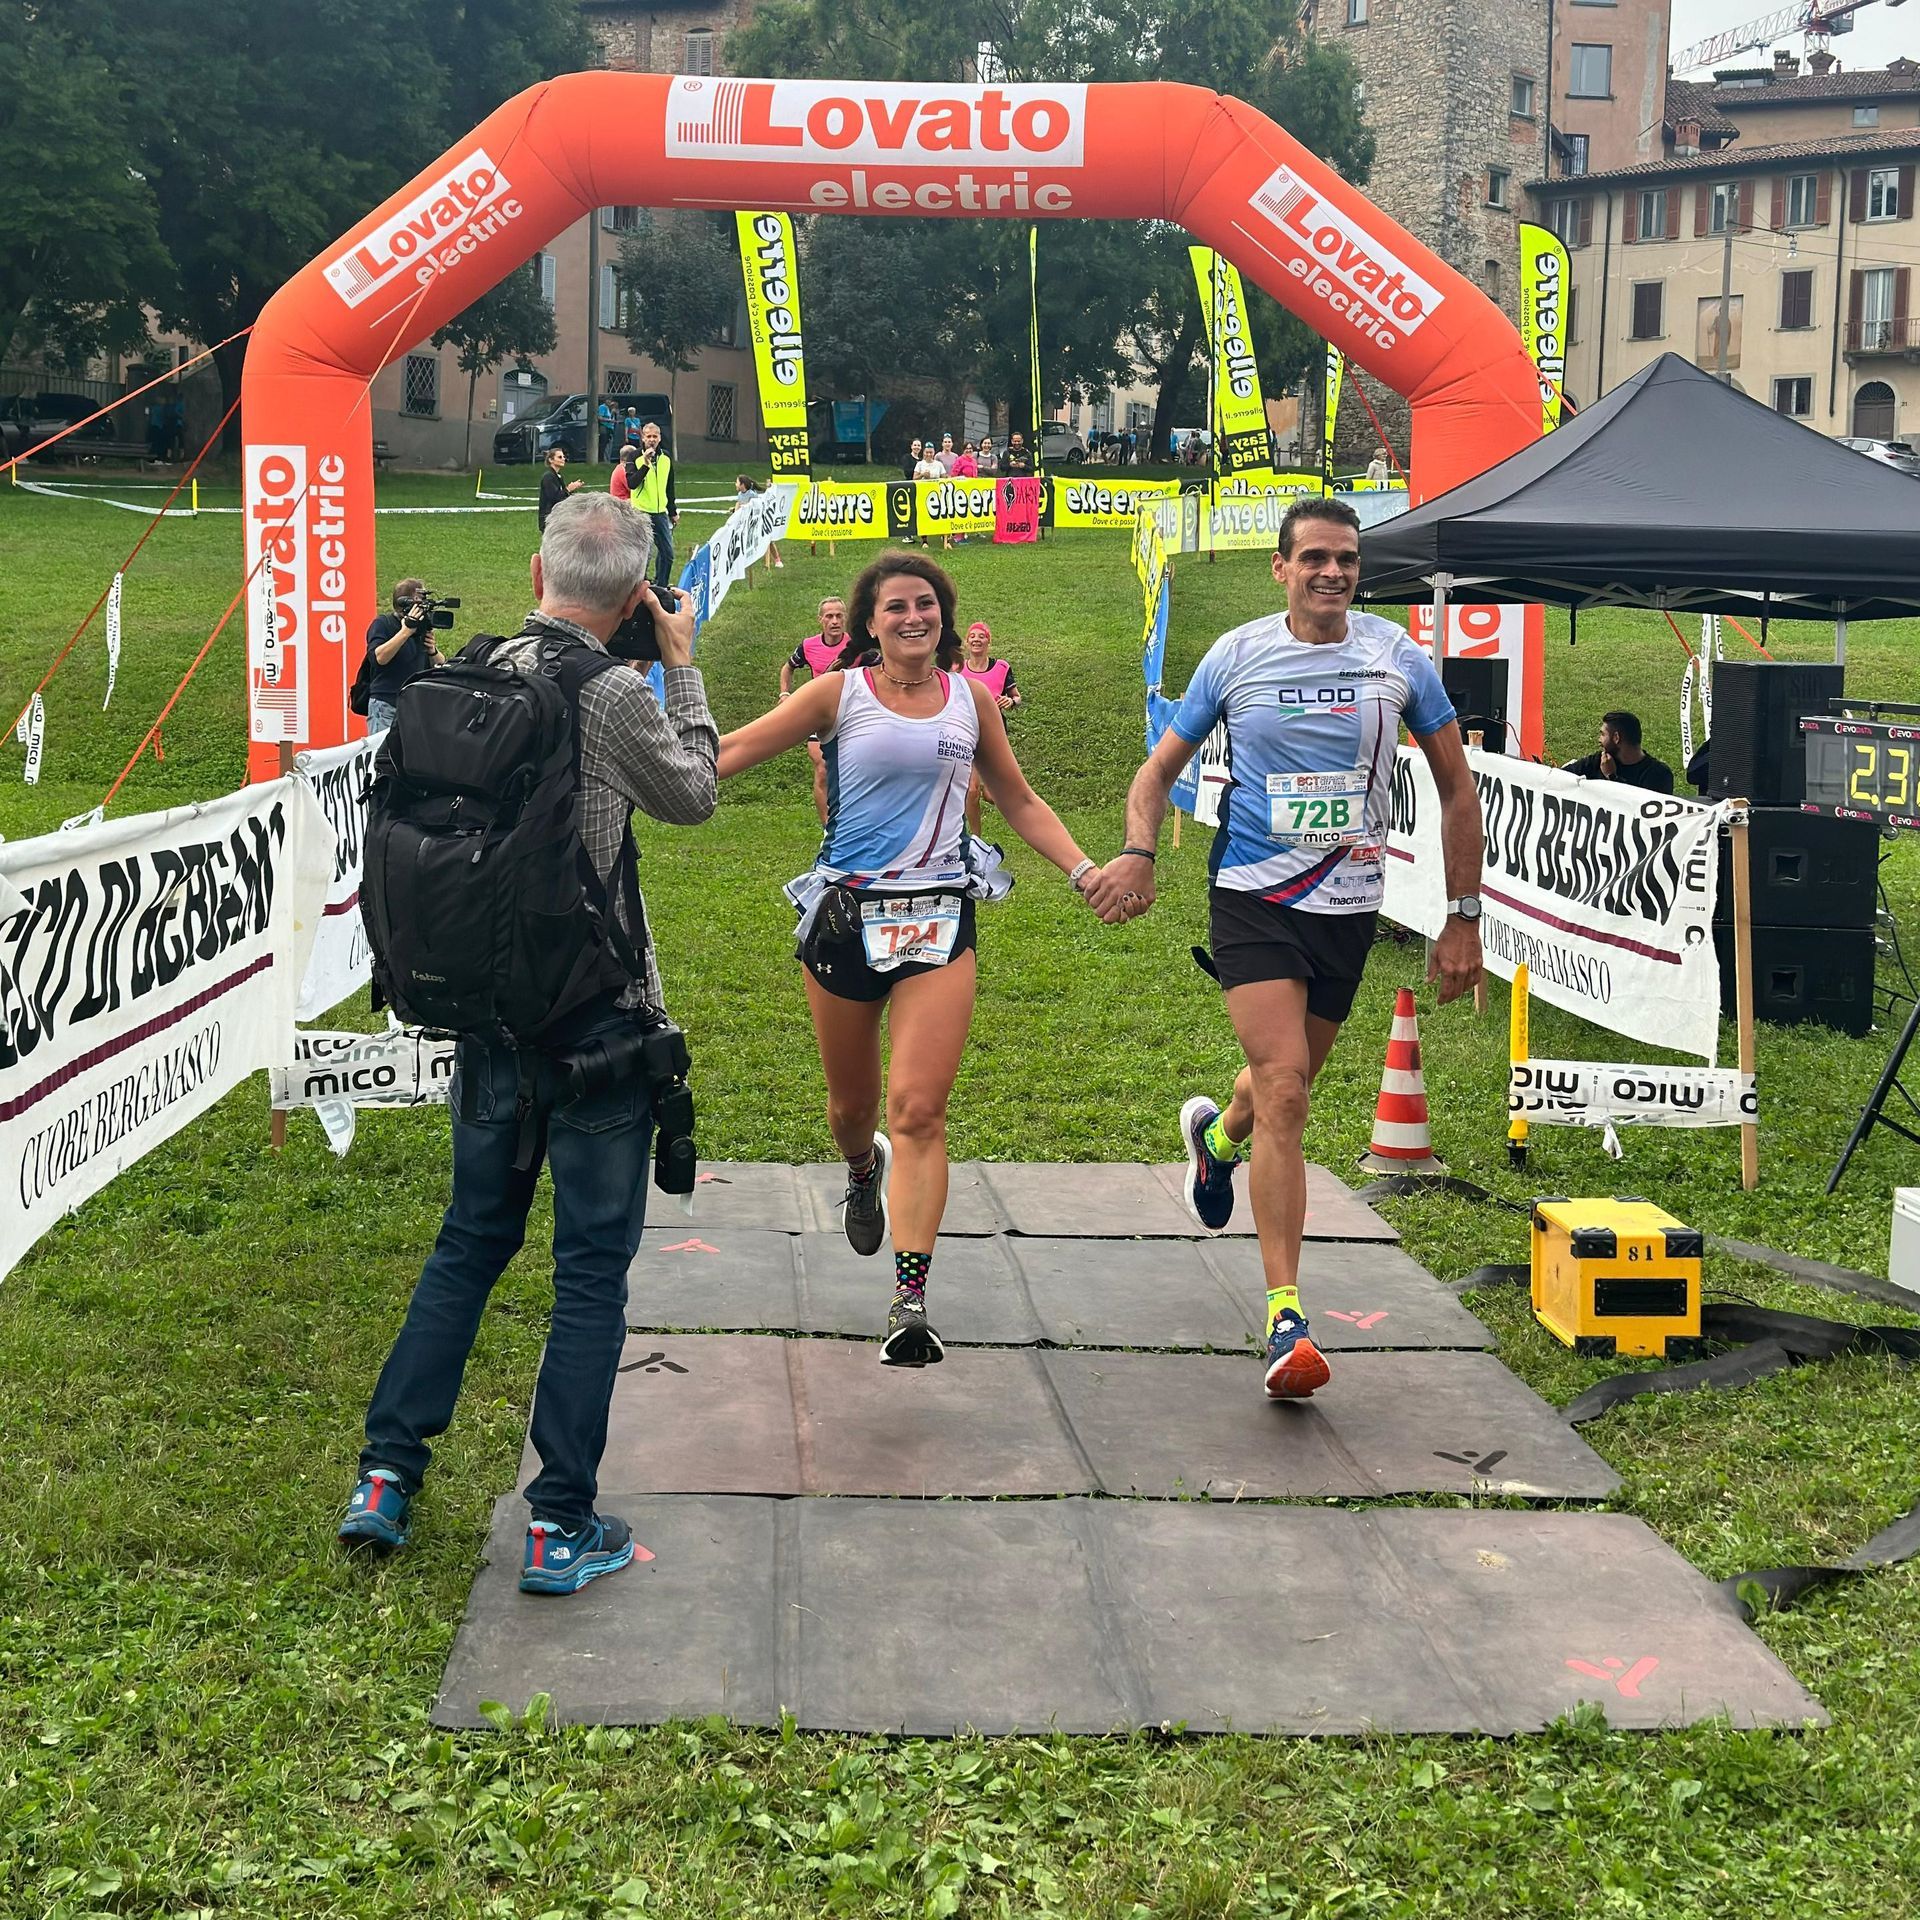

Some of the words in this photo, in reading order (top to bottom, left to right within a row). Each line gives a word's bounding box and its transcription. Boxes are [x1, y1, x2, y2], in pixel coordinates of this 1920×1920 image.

[741, 83, 1070, 152] Lovato
[809, 170, 1073, 210] electric
[353, 164, 496, 280] Lovato
[415, 198, 523, 287] electric
[1284, 192, 1424, 322] Lovato
[1288, 256, 1397, 351] electric
[798, 481, 873, 524] elleerre
[925, 481, 997, 520] elleer
[309, 454, 346, 643] electric
[1279, 688, 1356, 704] CLOD
[28, 733, 41, 765] mico
[1851, 745, 1920, 807] 2.3
[1288, 799, 1350, 829] 72B
[1304, 831, 1340, 843] mico
[1505, 784, 1534, 883] DI
[1536, 793, 1680, 926] BERGAMO
[1330, 896, 1367, 906] macron
[69, 855, 142, 1026] DI
[880, 921, 939, 954] 72A
[1514, 930, 1612, 1005] BERGAMASCO
[303, 1064, 397, 1098] mico
[1613, 1078, 1705, 1114] mico
[19, 1100, 89, 1209] CUORE
[89, 1019, 222, 1161] BERGAMASCO
